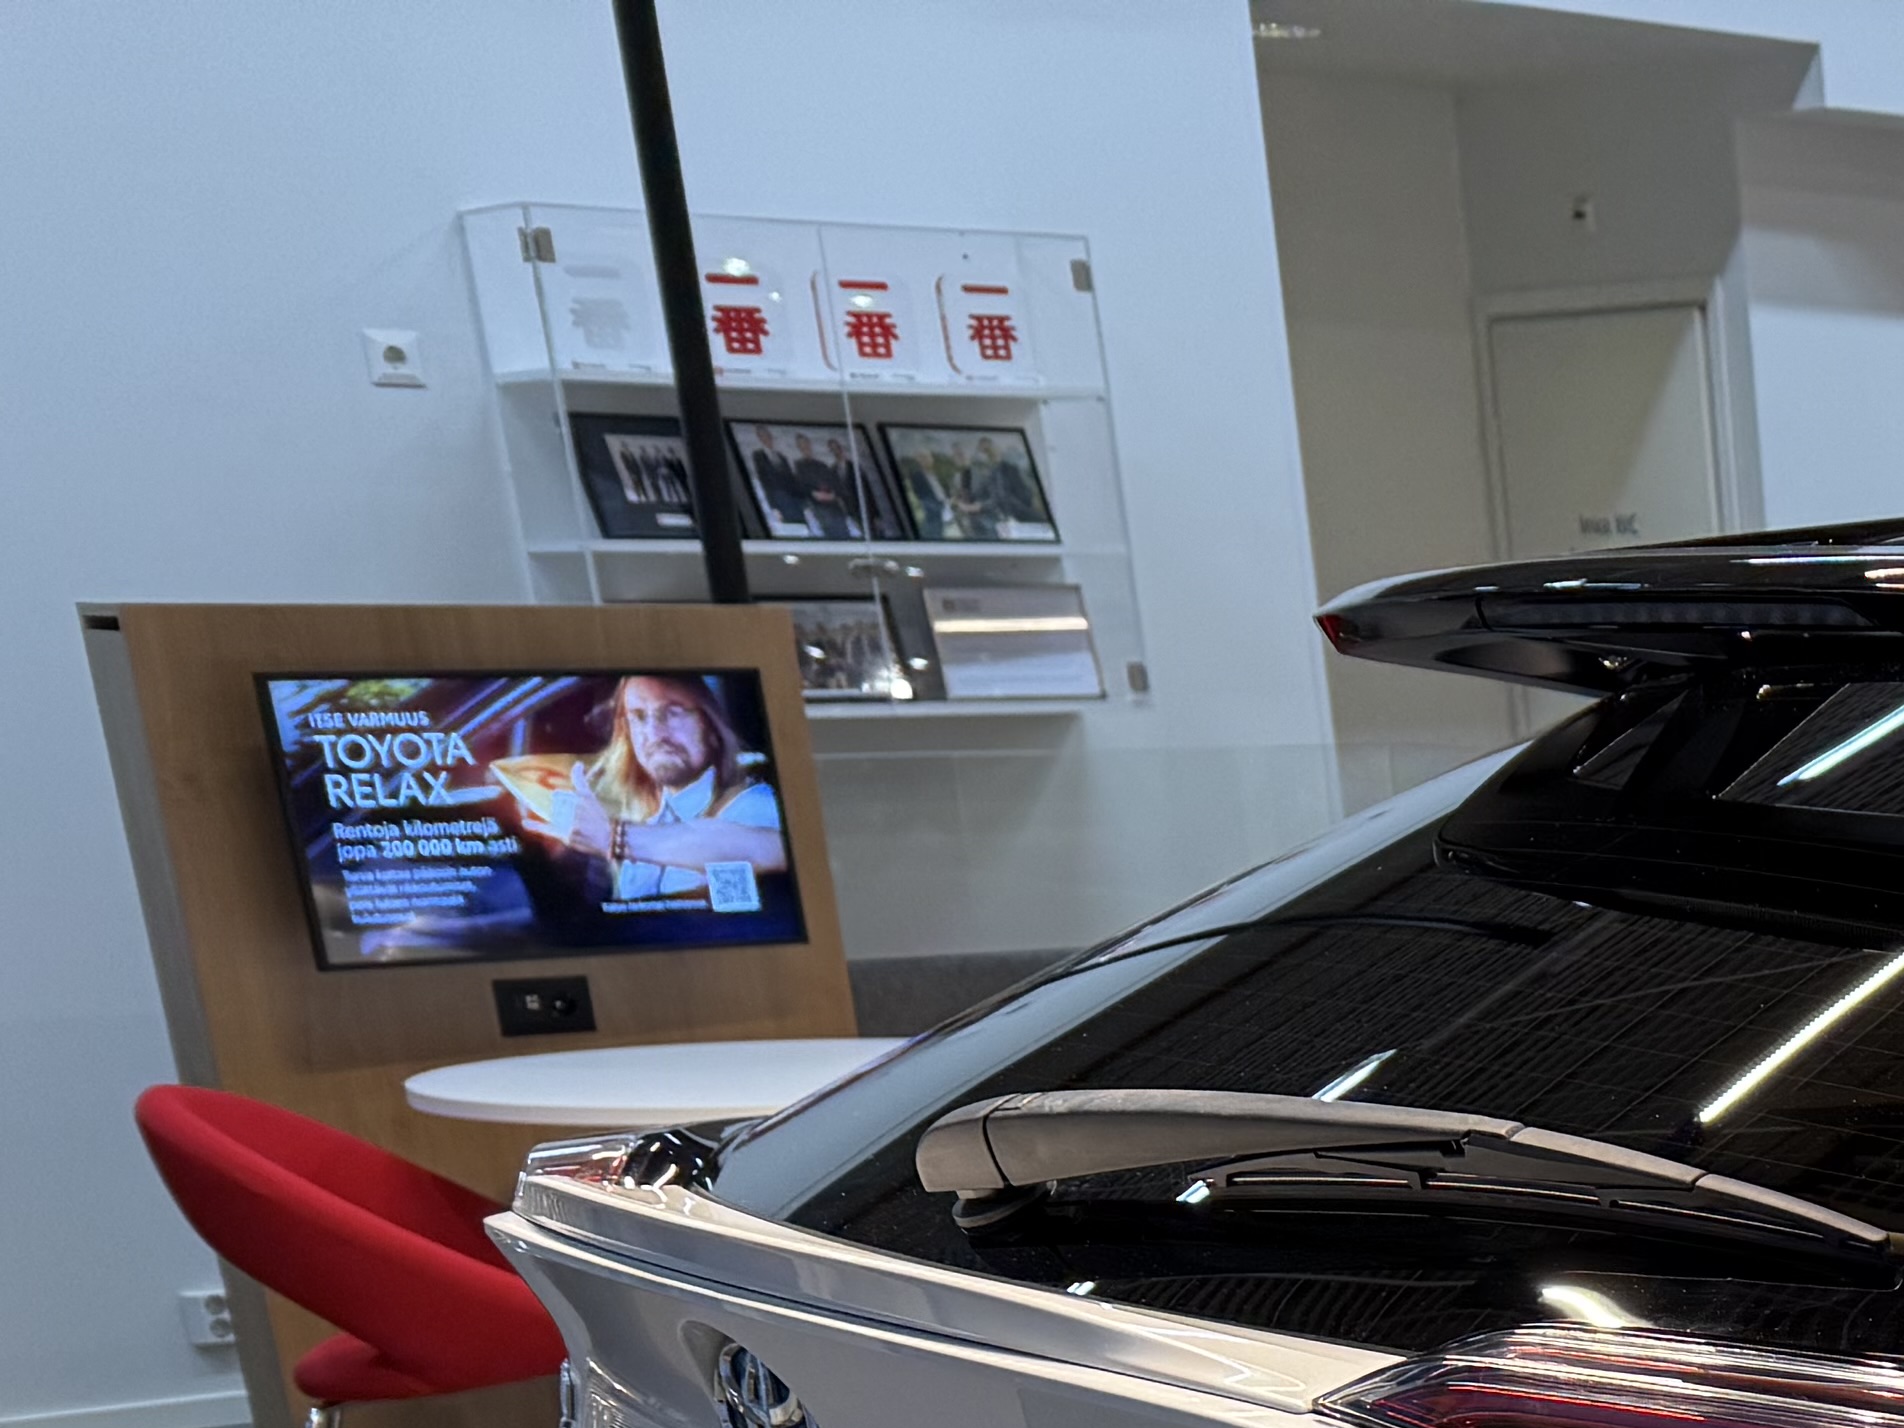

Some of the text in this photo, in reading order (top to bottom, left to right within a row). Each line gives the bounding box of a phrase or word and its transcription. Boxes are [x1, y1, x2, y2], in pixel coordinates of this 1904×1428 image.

[347, 710, 430, 727] VARMUUS
[313, 732, 478, 769] TOYOTA
[323, 771, 453, 808] RELAX
[332, 816, 499, 840] Rentoja kilometrejä
[336, 843, 377, 864] jopa
[380, 839, 415, 859] 200
[417, 837, 453, 857] 000
[455, 837, 485, 855] km
